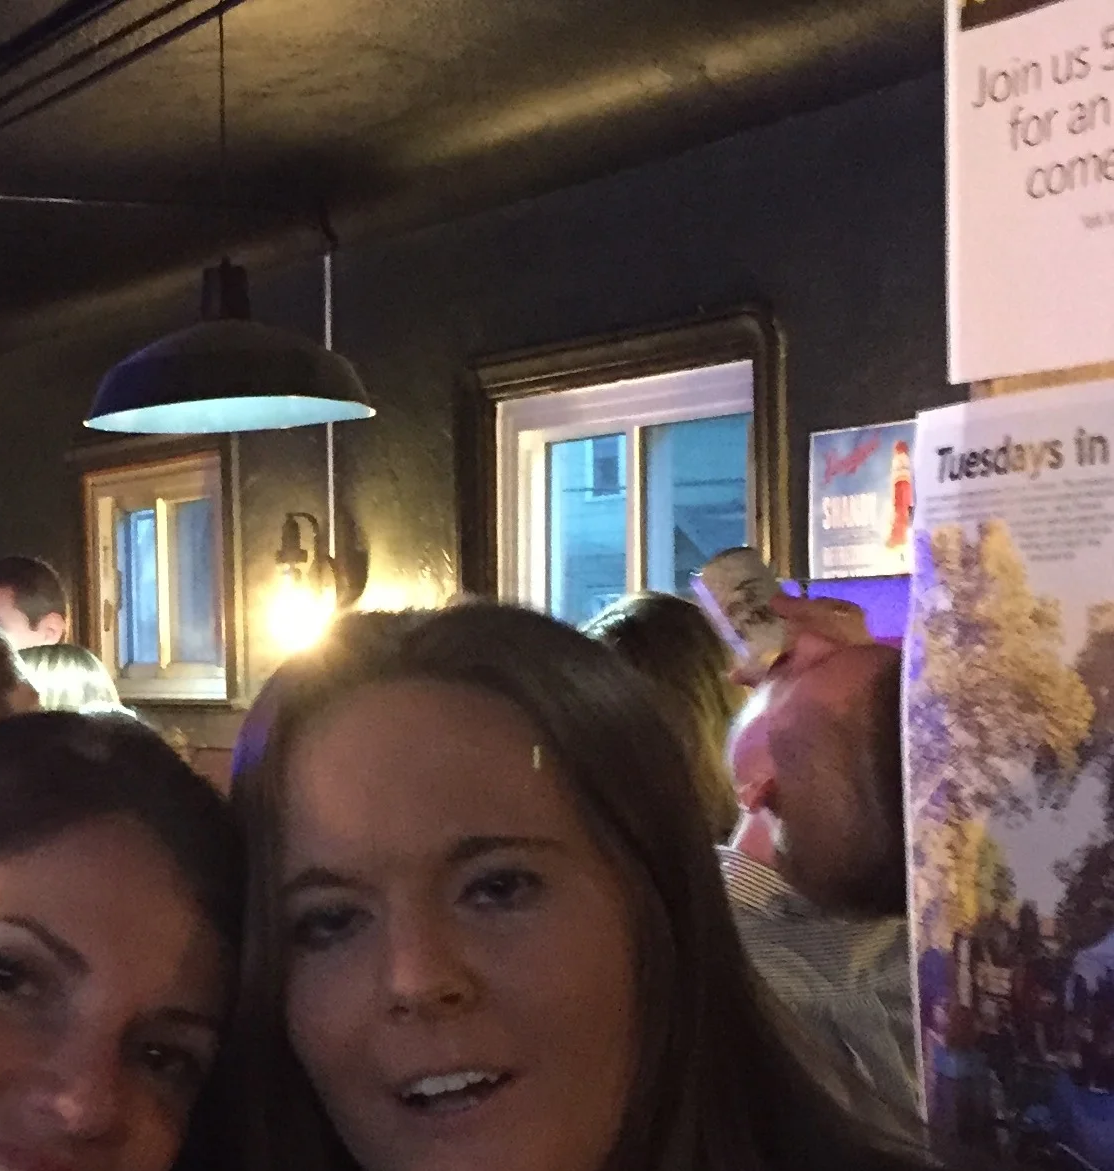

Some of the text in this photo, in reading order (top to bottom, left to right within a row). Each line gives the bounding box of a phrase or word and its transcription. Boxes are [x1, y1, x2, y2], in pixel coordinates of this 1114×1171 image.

[971, 57, 1042, 108] Join
[1051, 45, 1091, 84] us
[1009, 96, 1111, 151] for an
[937, 434, 1065, 484] Tuesdays
[1074, 426, 1110, 467] in
